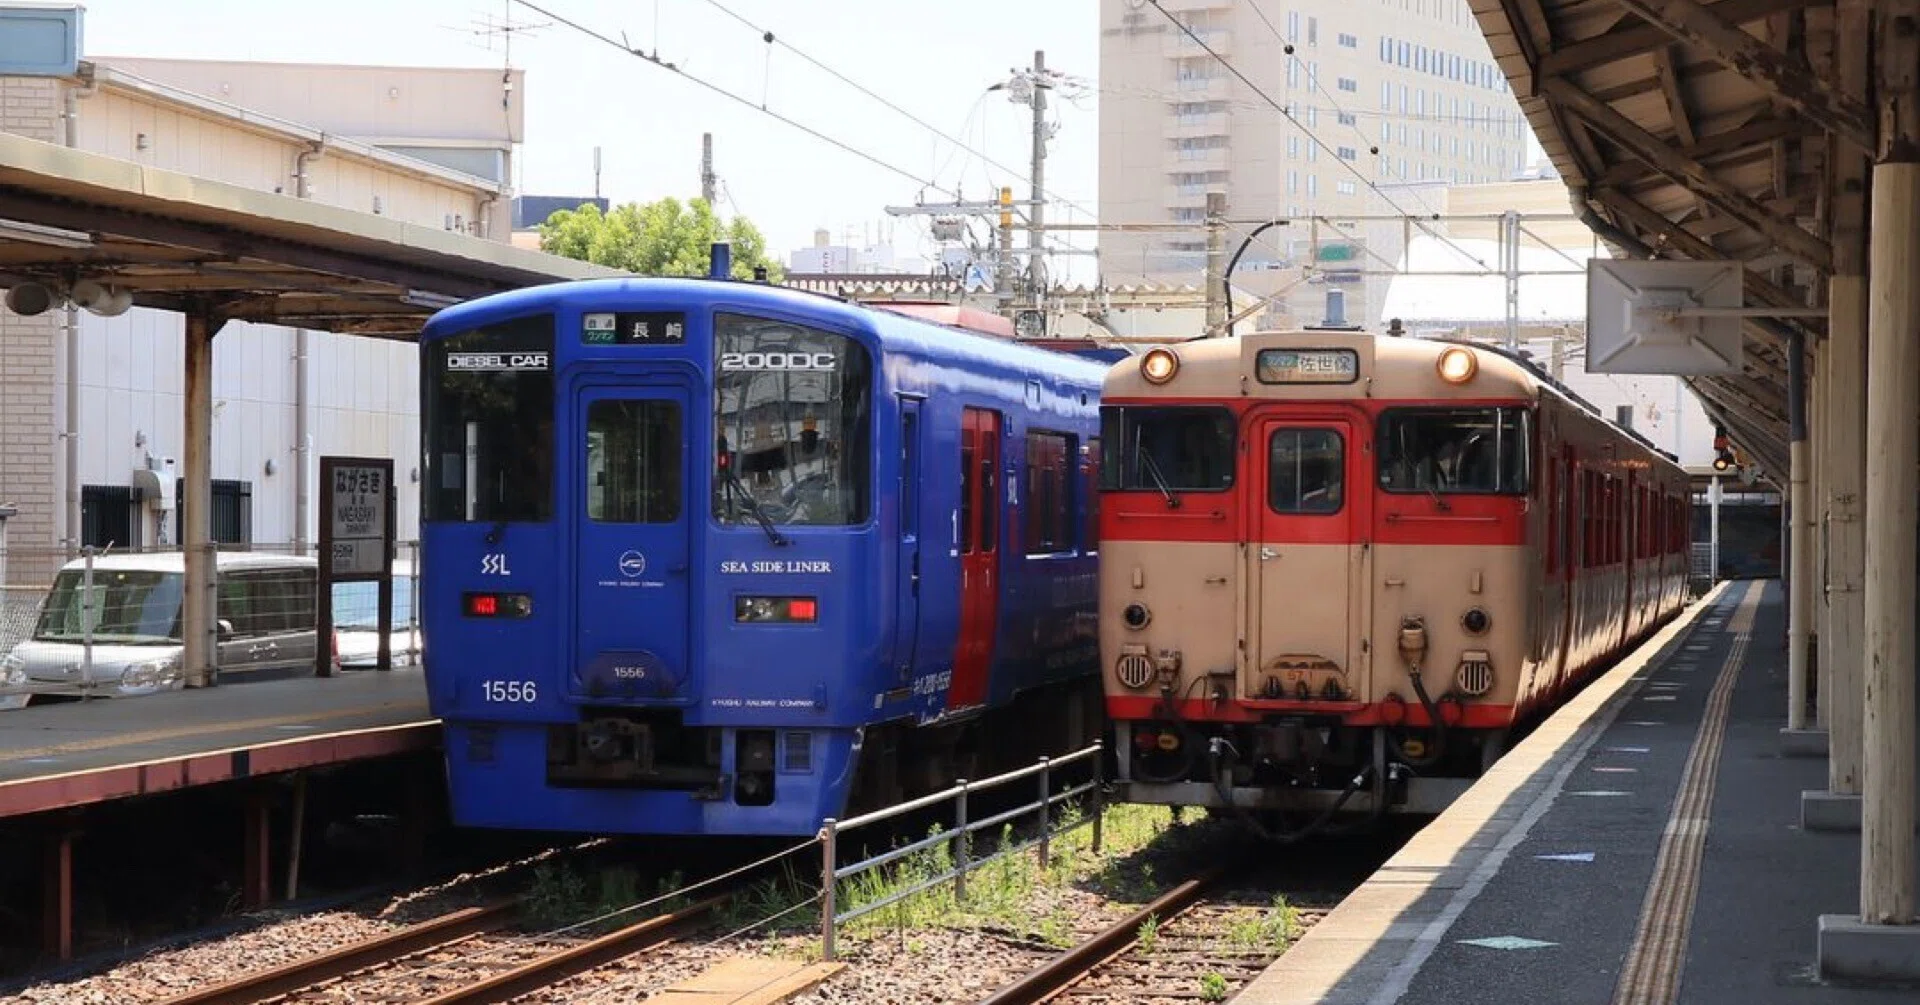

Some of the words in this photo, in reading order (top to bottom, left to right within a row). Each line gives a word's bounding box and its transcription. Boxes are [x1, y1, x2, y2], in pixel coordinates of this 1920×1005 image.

[633, 321, 682, 338] 長崎
[447, 355, 507, 369] DIESEL
[511, 355, 548, 367] CAR
[722, 352, 835, 371] 200DC
[1301, 355, 1351, 372] 佐世保
[335, 469, 380, 494] ながさき
[481, 554, 511, 576] SSL
[721, 560, 748, 573] SEA
[751, 560, 785, 573] SIDE
[787, 560, 832, 573] LINER
[614, 666, 645, 679] 1556
[482, 680, 537, 702] 1556
